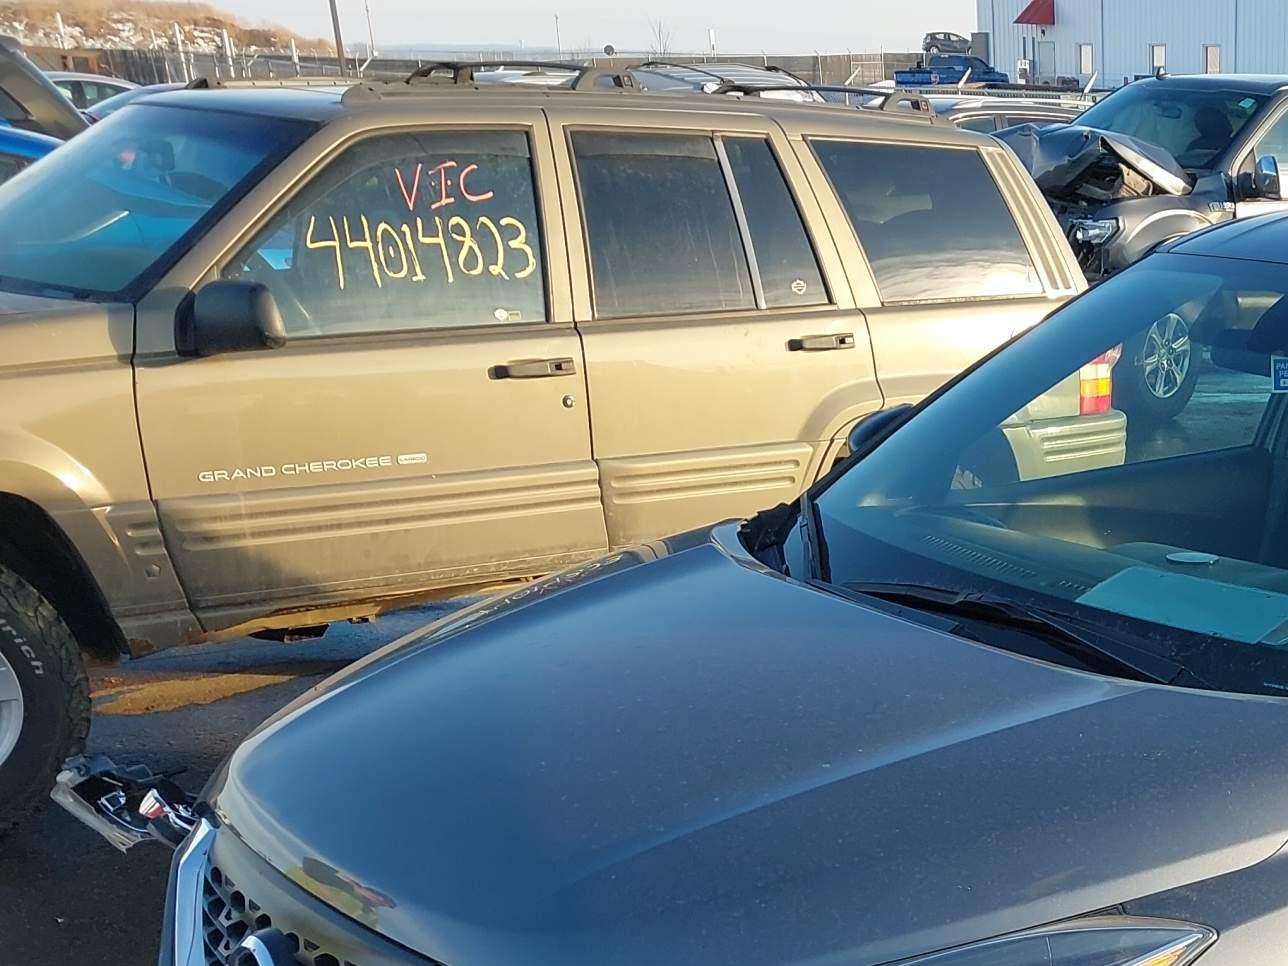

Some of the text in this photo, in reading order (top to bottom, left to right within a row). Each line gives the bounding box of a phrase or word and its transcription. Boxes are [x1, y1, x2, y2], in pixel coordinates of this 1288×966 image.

[394, 160, 494, 211] VIC
[306, 212, 537, 289] 44014823
[198, 465, 277, 482] GRAND
[281, 455, 393, 475] CHEROKEE
